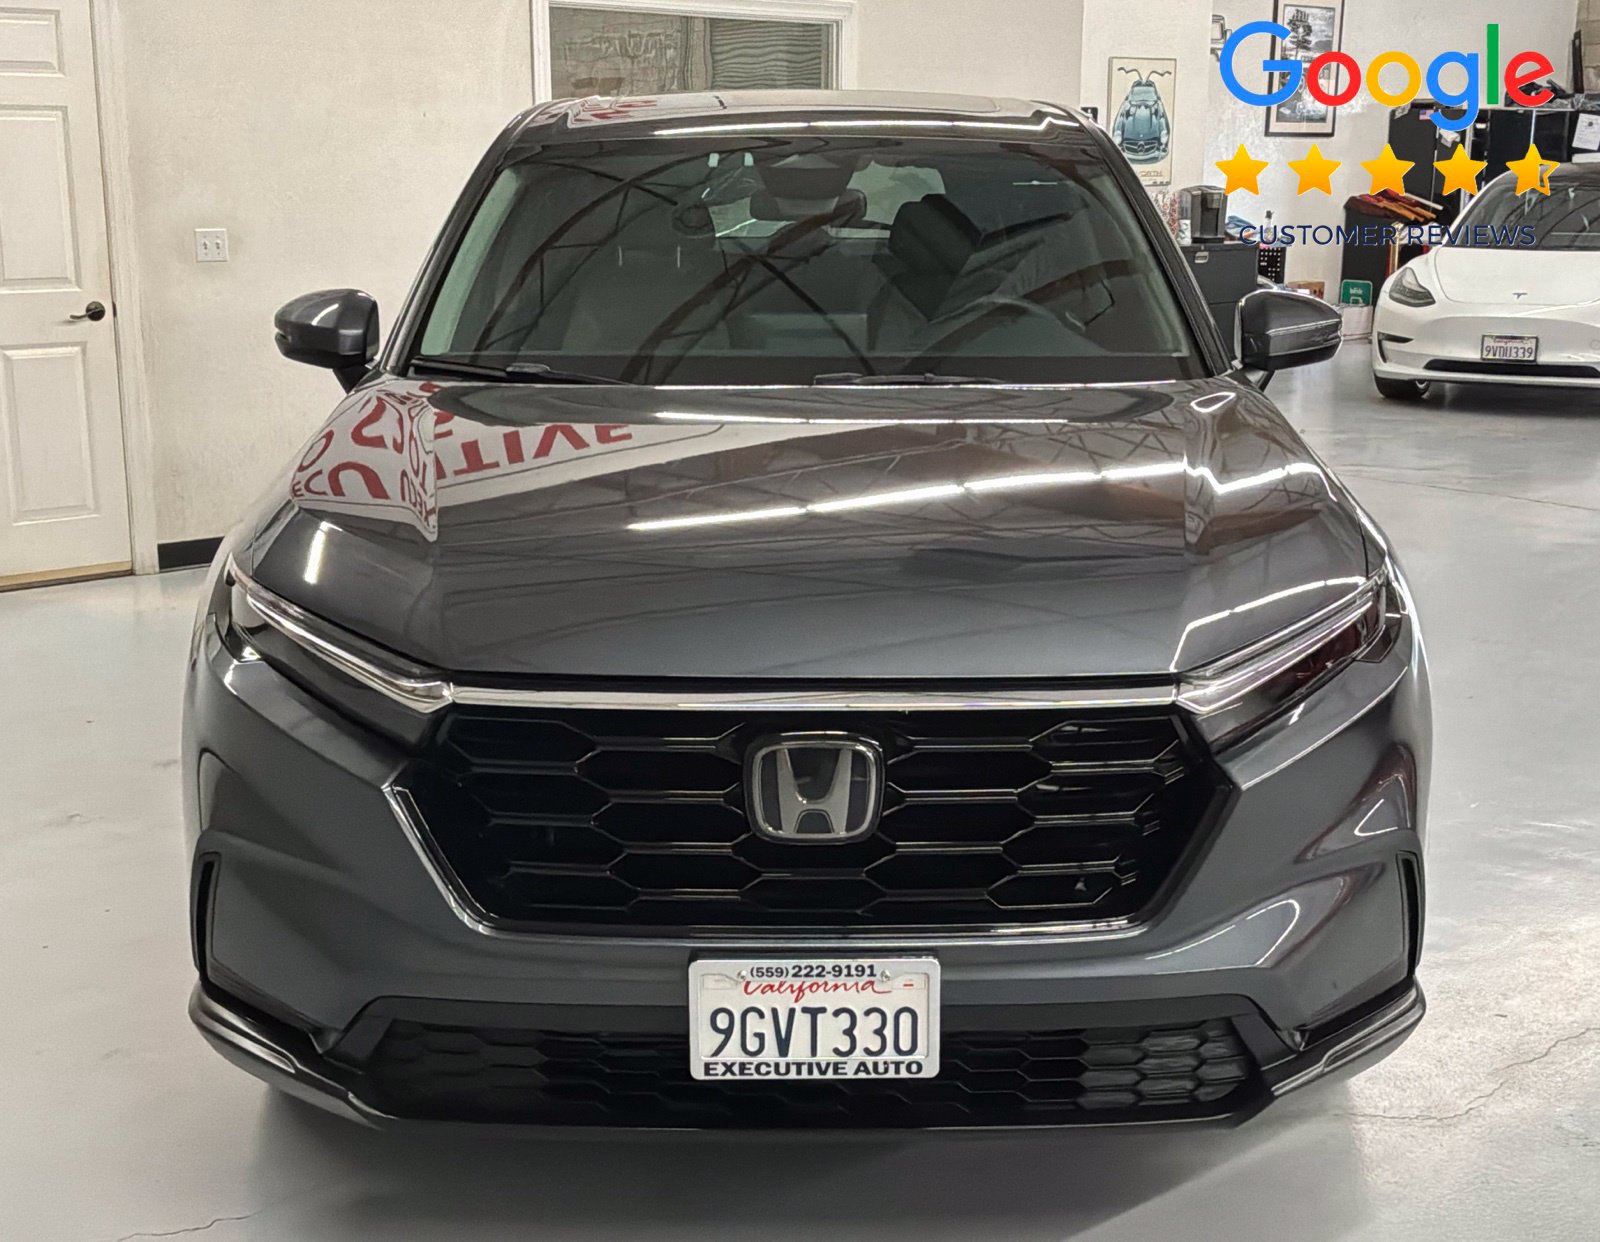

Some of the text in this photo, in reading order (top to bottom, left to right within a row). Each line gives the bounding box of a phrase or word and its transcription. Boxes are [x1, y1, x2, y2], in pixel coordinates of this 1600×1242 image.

[750, 964, 877, 978] (559) 222-9191
[743, 979, 892, 1003] California
[709, 1006, 919, 1058] 9GVT330
[703, 1060, 923, 1077] EXECUTIVE AUTO
